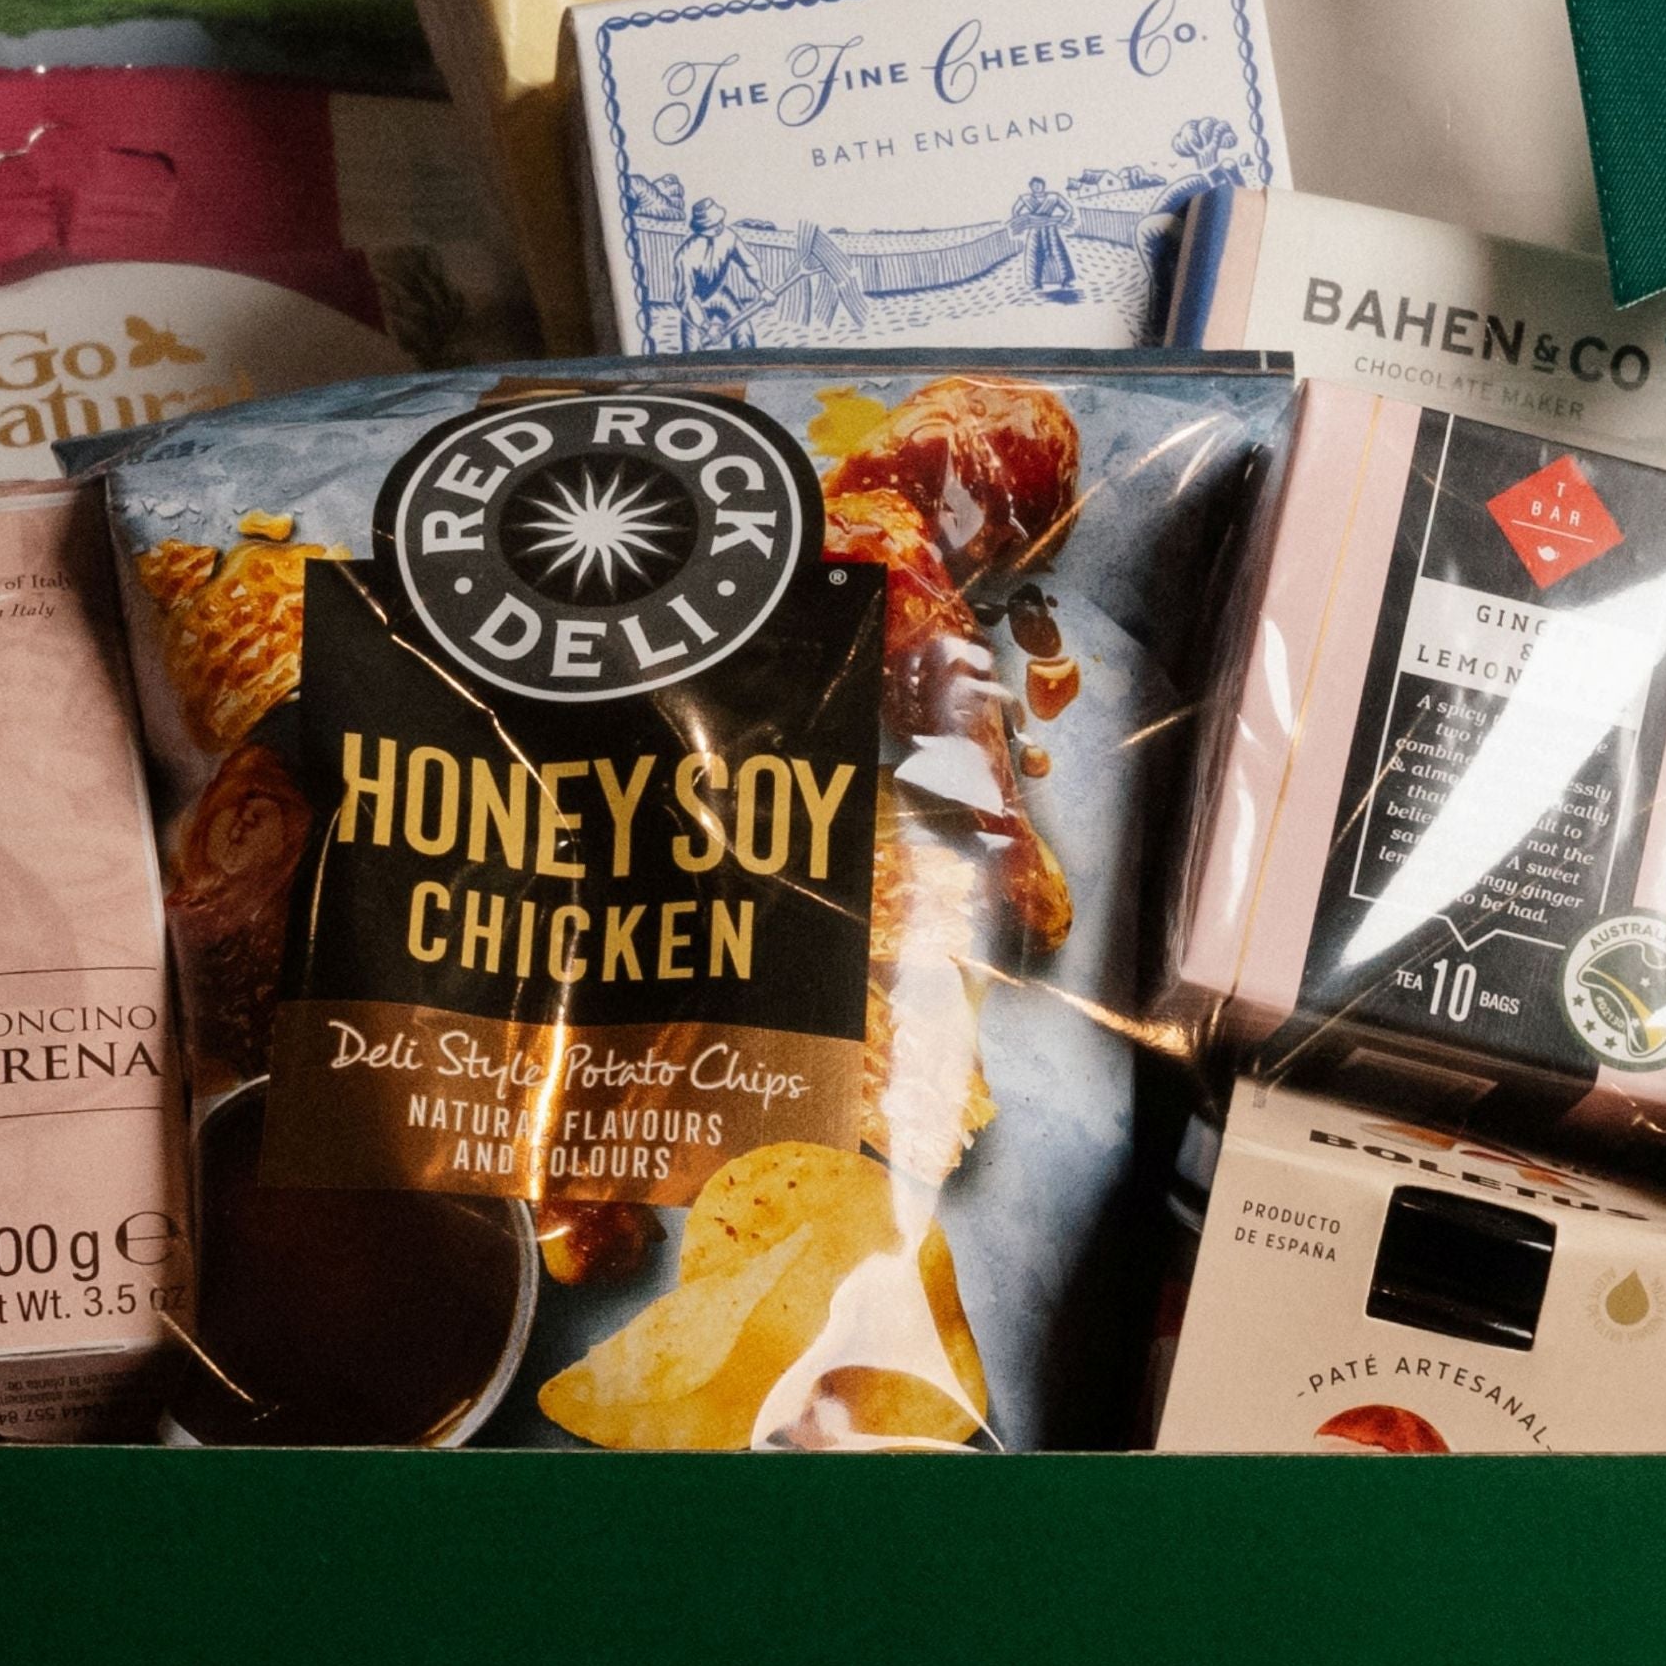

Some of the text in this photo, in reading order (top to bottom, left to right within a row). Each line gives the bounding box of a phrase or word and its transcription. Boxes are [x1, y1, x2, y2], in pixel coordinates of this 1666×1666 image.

[811, 111, 1075, 168] BATH ENGLAND
[1354, 355, 1585, 420] CHOCOLATE MAKER
[422, 405, 782, 562] RED ROCK
[1556, 480, 1566, 498] T
[1530, 499, 1581, 528] BAR
[4, 573, 27, 591] of
[9, 602, 56, 620] Italy
[469, 591, 720, 680] DELI
[1416, 694, 1431, 710] A
[1436, 700, 1487, 726] spicy
[1435, 721, 1471, 743] two
[337, 731, 857, 881] HONEY SOY
[1562, 820, 1583, 841] to
[1505, 855, 1522, 872] A
[1525, 860, 1582, 886] sweet
[1525, 837, 1559, 858] not
[1562, 844, 1595, 867] the
[1479, 892, 1504, 912] be
[1506, 900, 1549, 925] had.
[1520, 882, 1585, 910] ginger
[407, 880, 755, 985] CHICKEN
[1395, 957, 1522, 1023] TEA 10 BAGS
[327, 1020, 811, 1111] Deli Style Potato Chips
[562, 1109, 723, 1147] FLAVOURS
[452, 1139, 515, 1175] AND
[1308, 1128, 1651, 1223] BOLETUS
[1241, 1198, 1343, 1236] PRODUCTO
[1233, 1225, 1338, 1264] DE ESPAÑA
[16, 1288, 71, 1323] Wt.
[82, 1283, 137, 1318] 3.5
